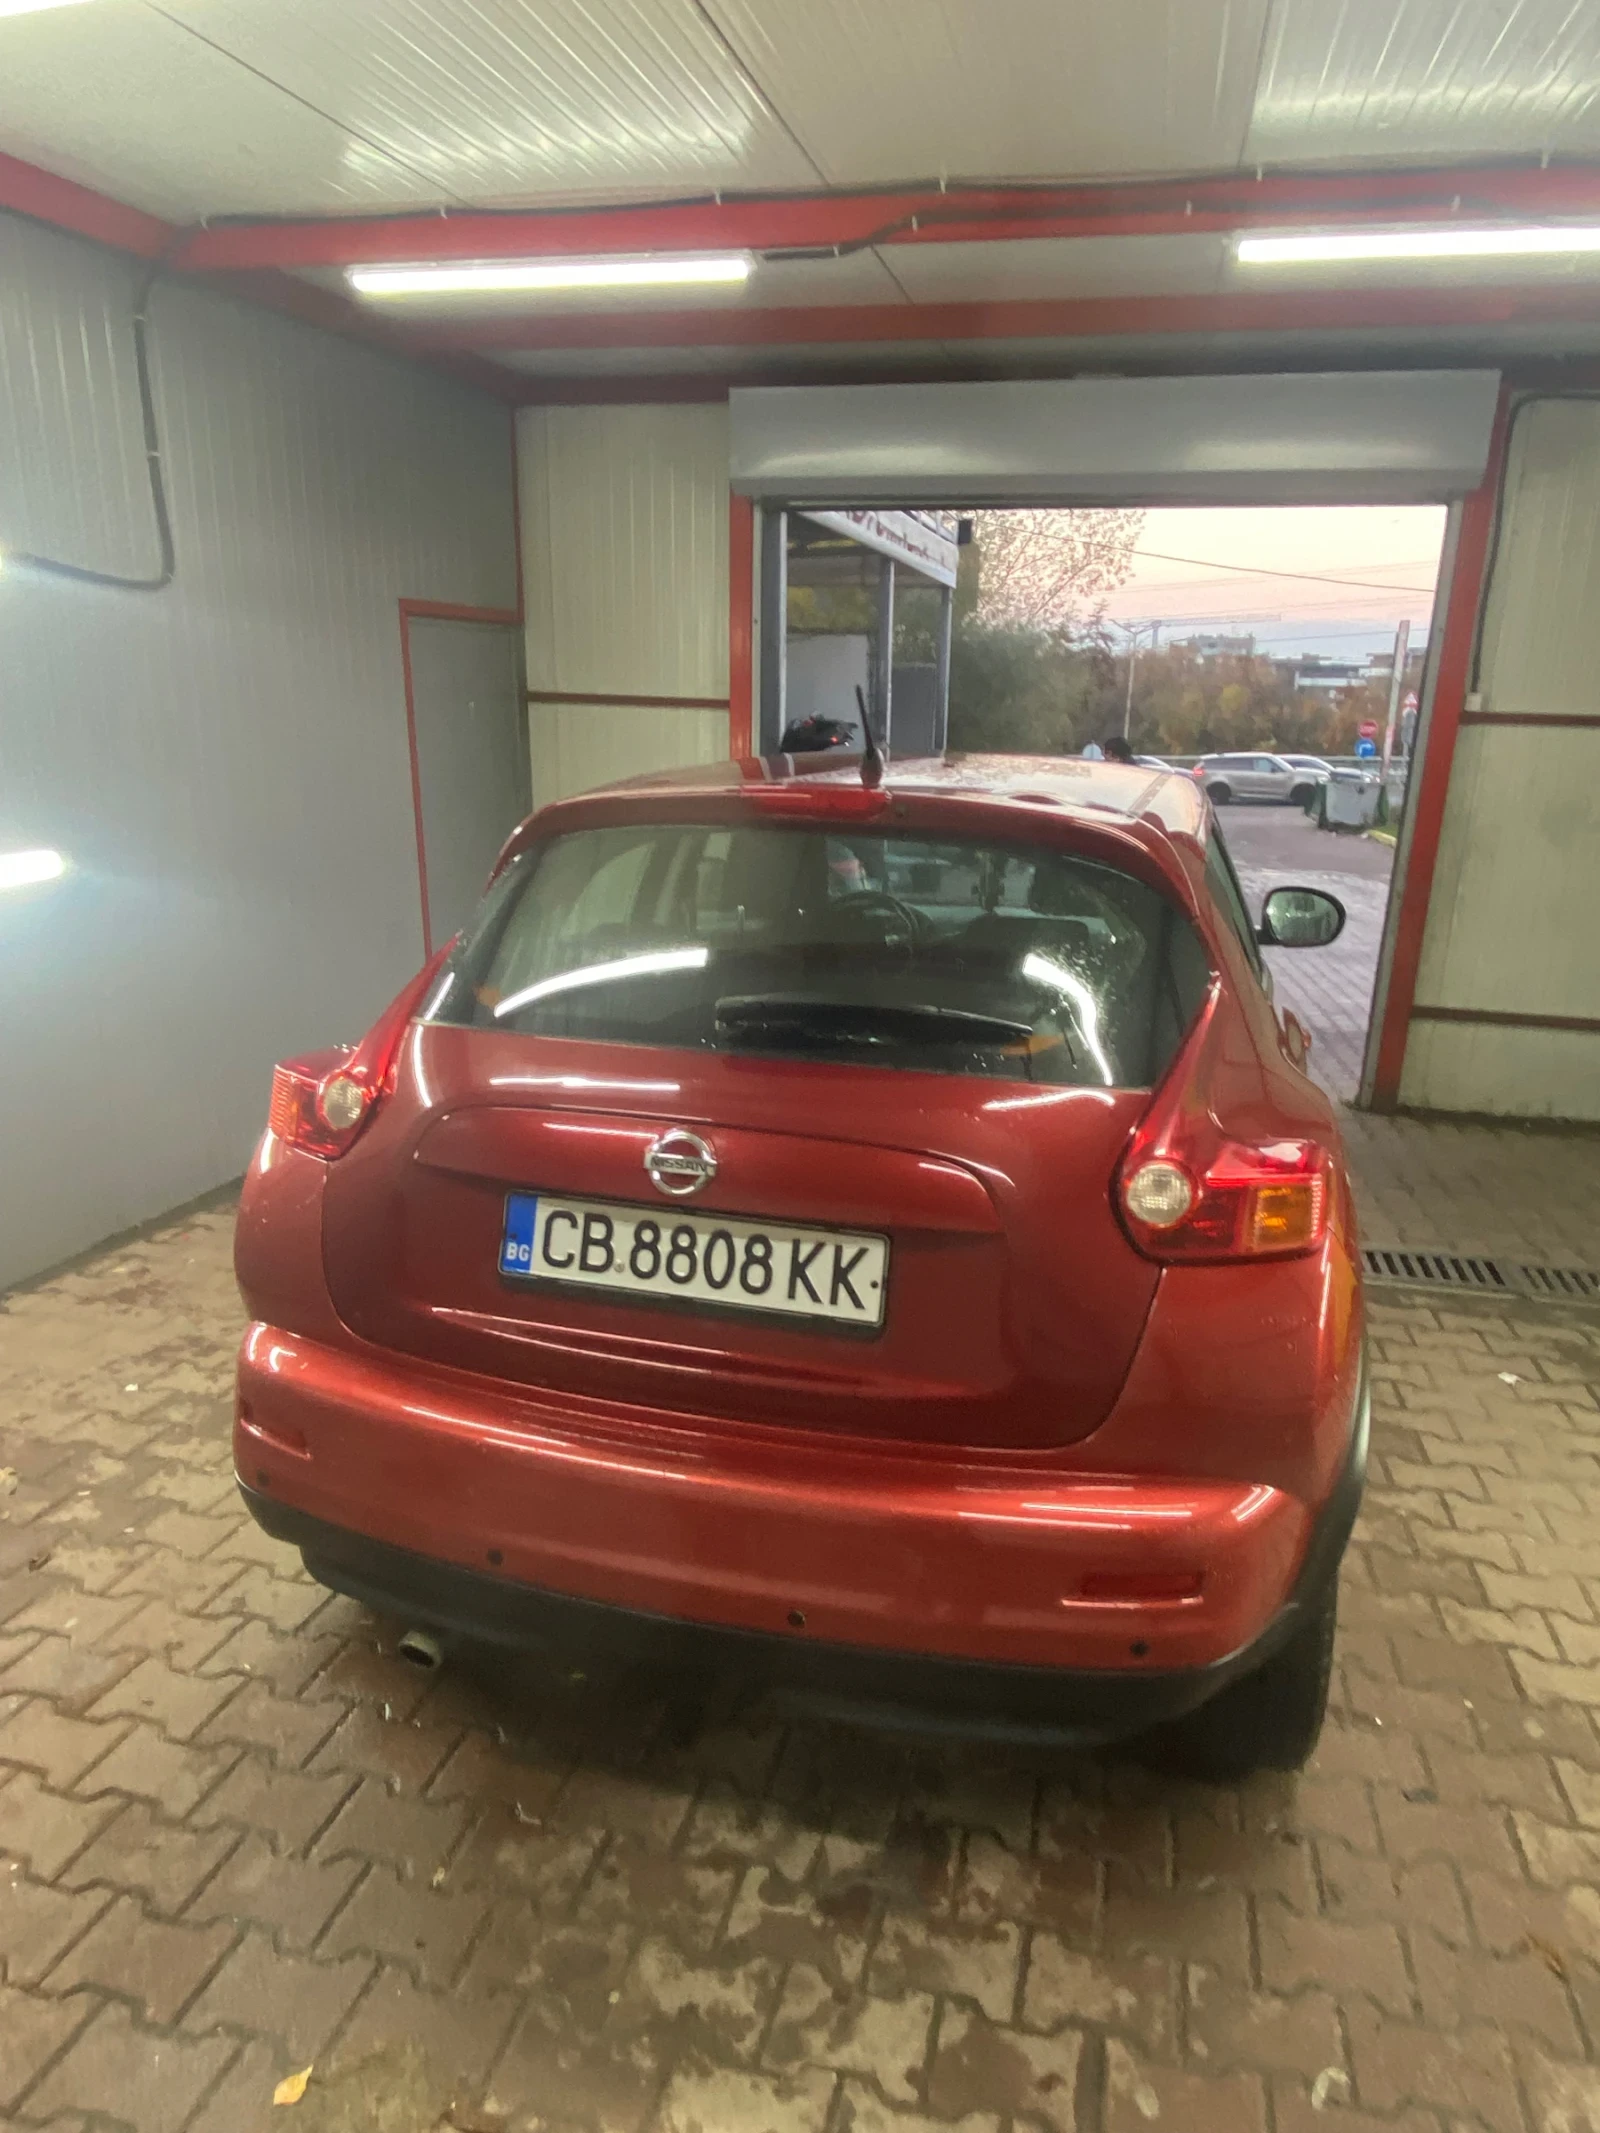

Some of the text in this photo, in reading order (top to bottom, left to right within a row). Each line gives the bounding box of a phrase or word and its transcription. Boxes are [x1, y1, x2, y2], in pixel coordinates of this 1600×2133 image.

[650, 1155, 706, 1173] NISSAN
[506, 1241, 530, 1262] BG
[542, 1209, 869, 1310] CB 8808 KK
